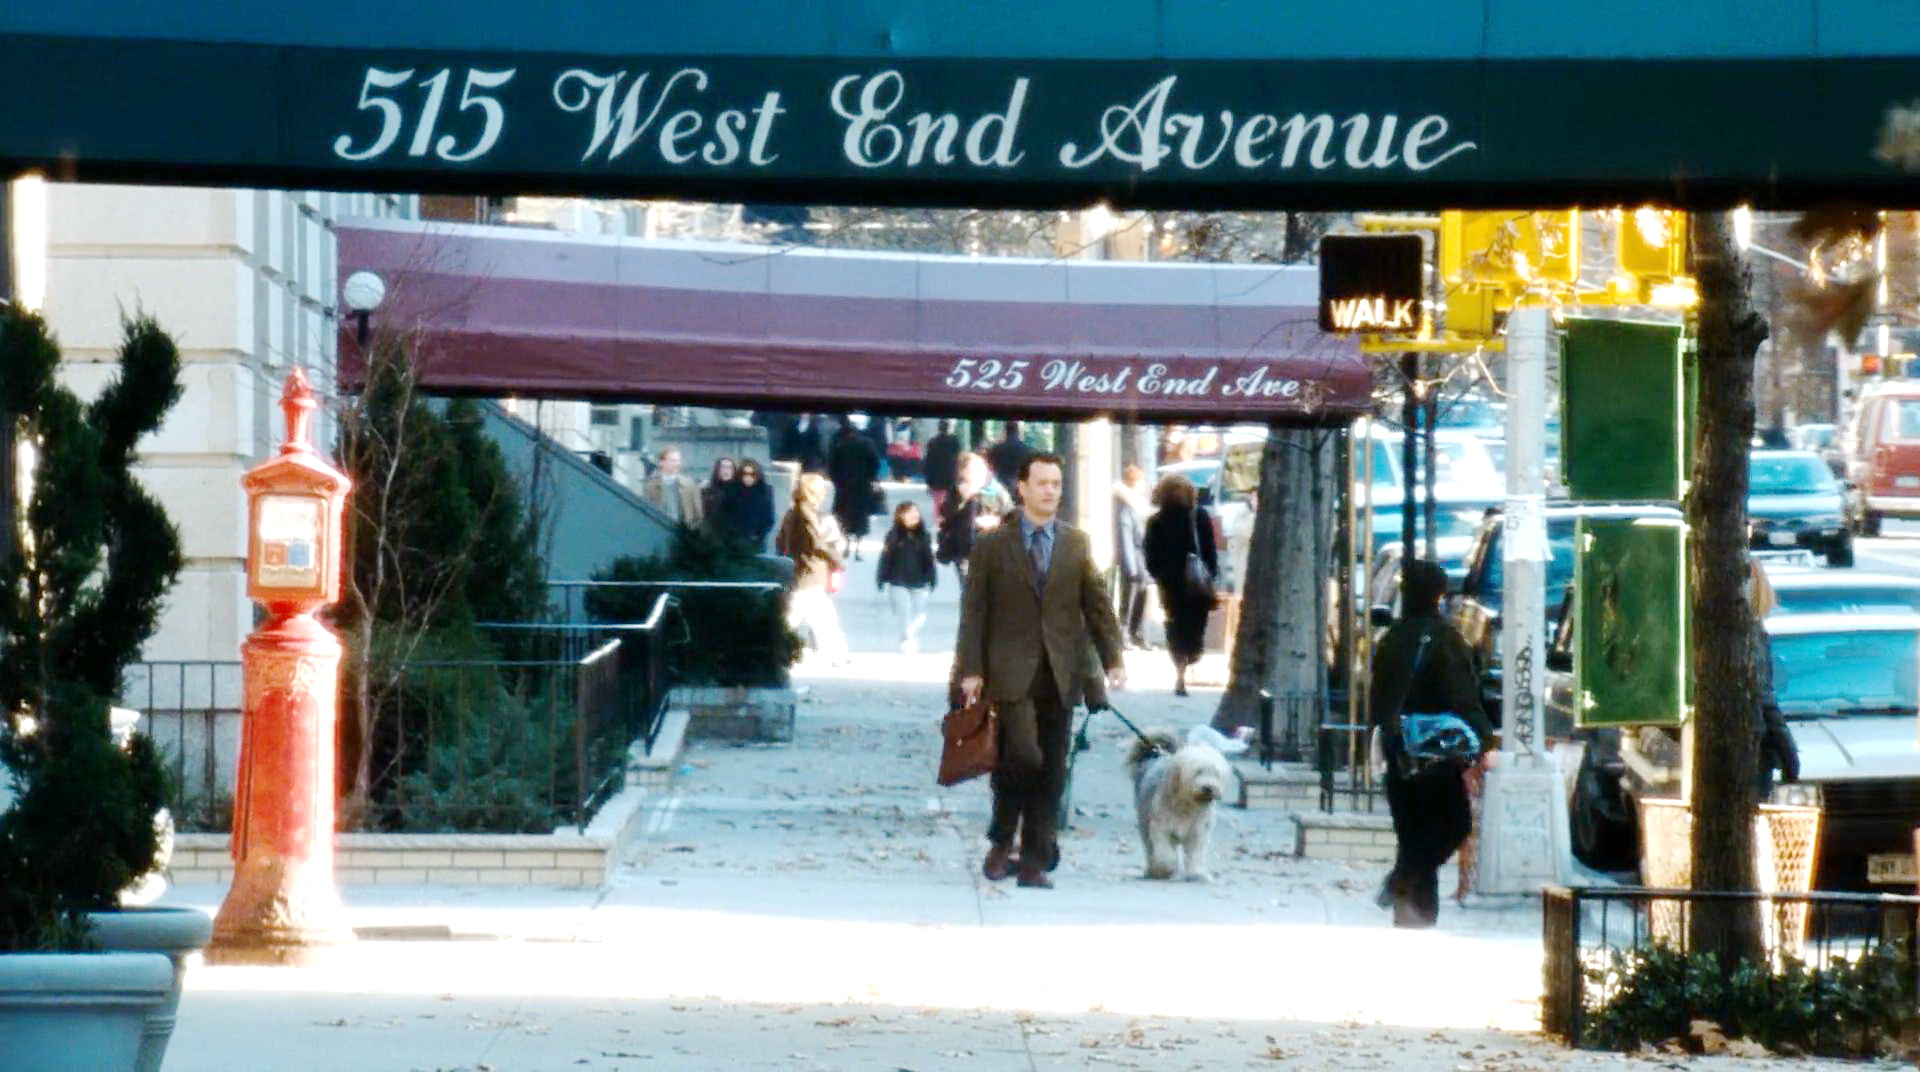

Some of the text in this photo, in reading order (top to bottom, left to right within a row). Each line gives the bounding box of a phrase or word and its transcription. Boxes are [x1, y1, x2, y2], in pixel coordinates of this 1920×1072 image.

[333, 67, 1478, 173] 515 West End Avenue
[1329, 296, 1415, 329] WALK
[945, 358, 1300, 397] 525 West End Ave
